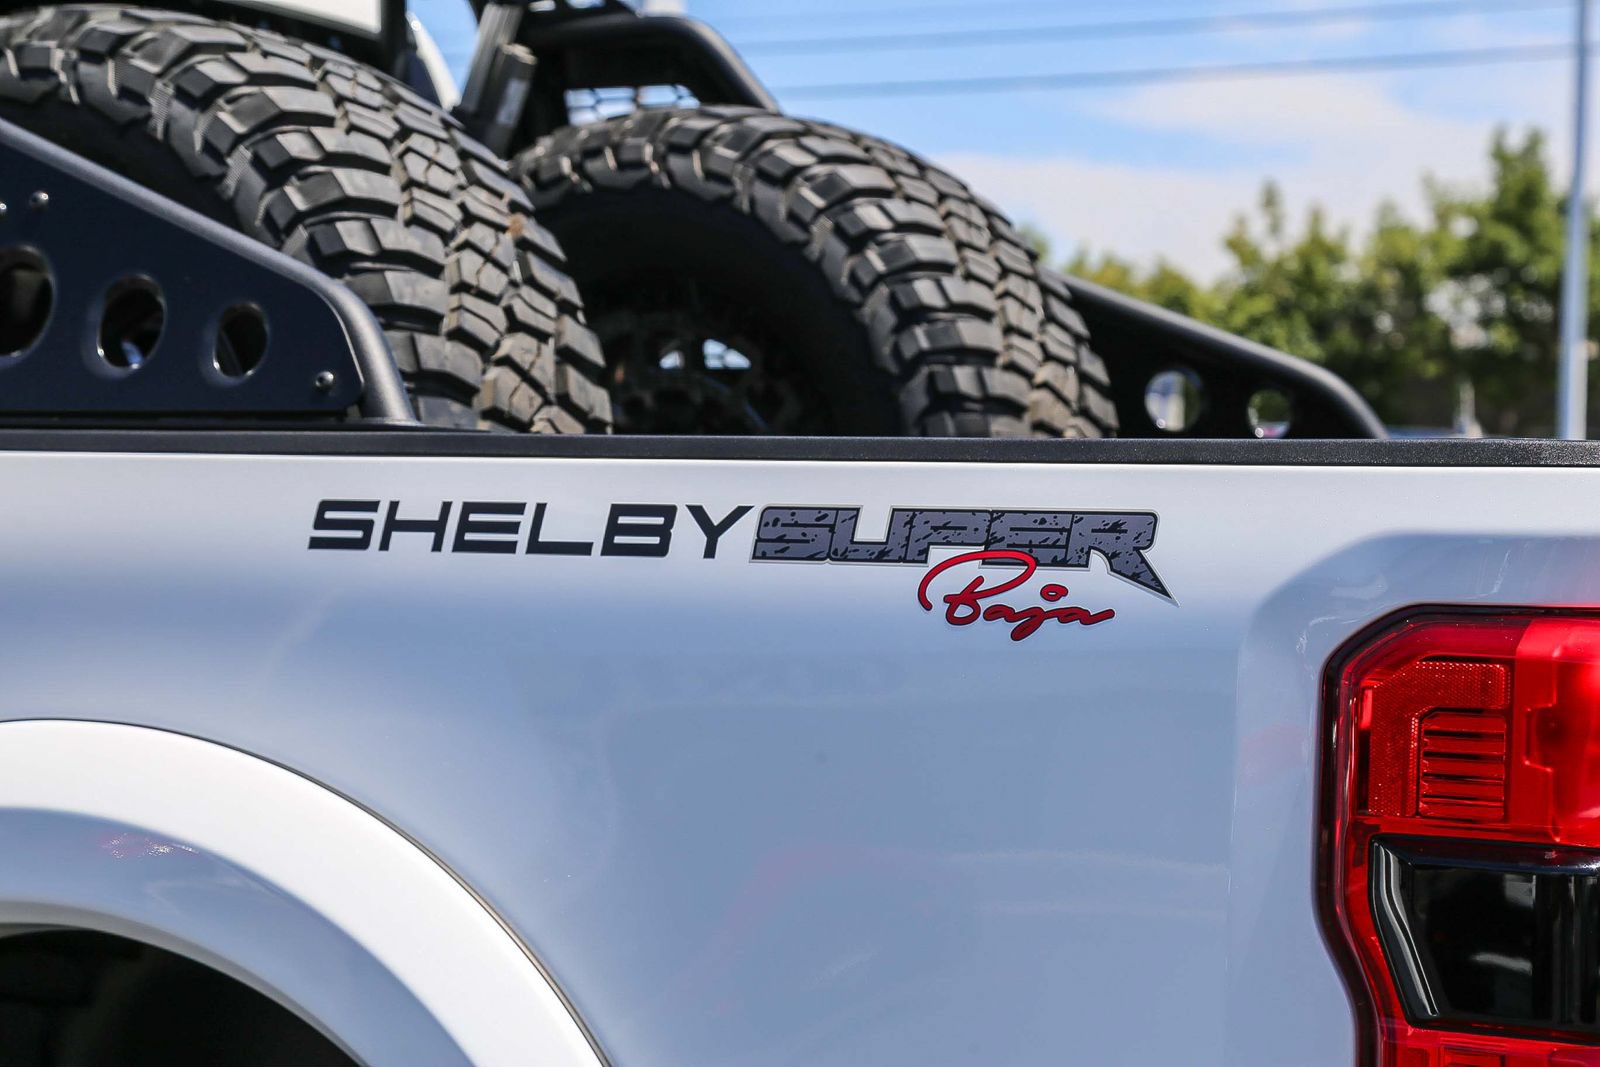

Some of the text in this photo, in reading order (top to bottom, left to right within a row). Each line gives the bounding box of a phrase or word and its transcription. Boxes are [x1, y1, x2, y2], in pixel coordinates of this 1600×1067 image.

[308, 499, 1177, 605] SHELBY SUPER
[917, 550, 1115, 642] Baja
